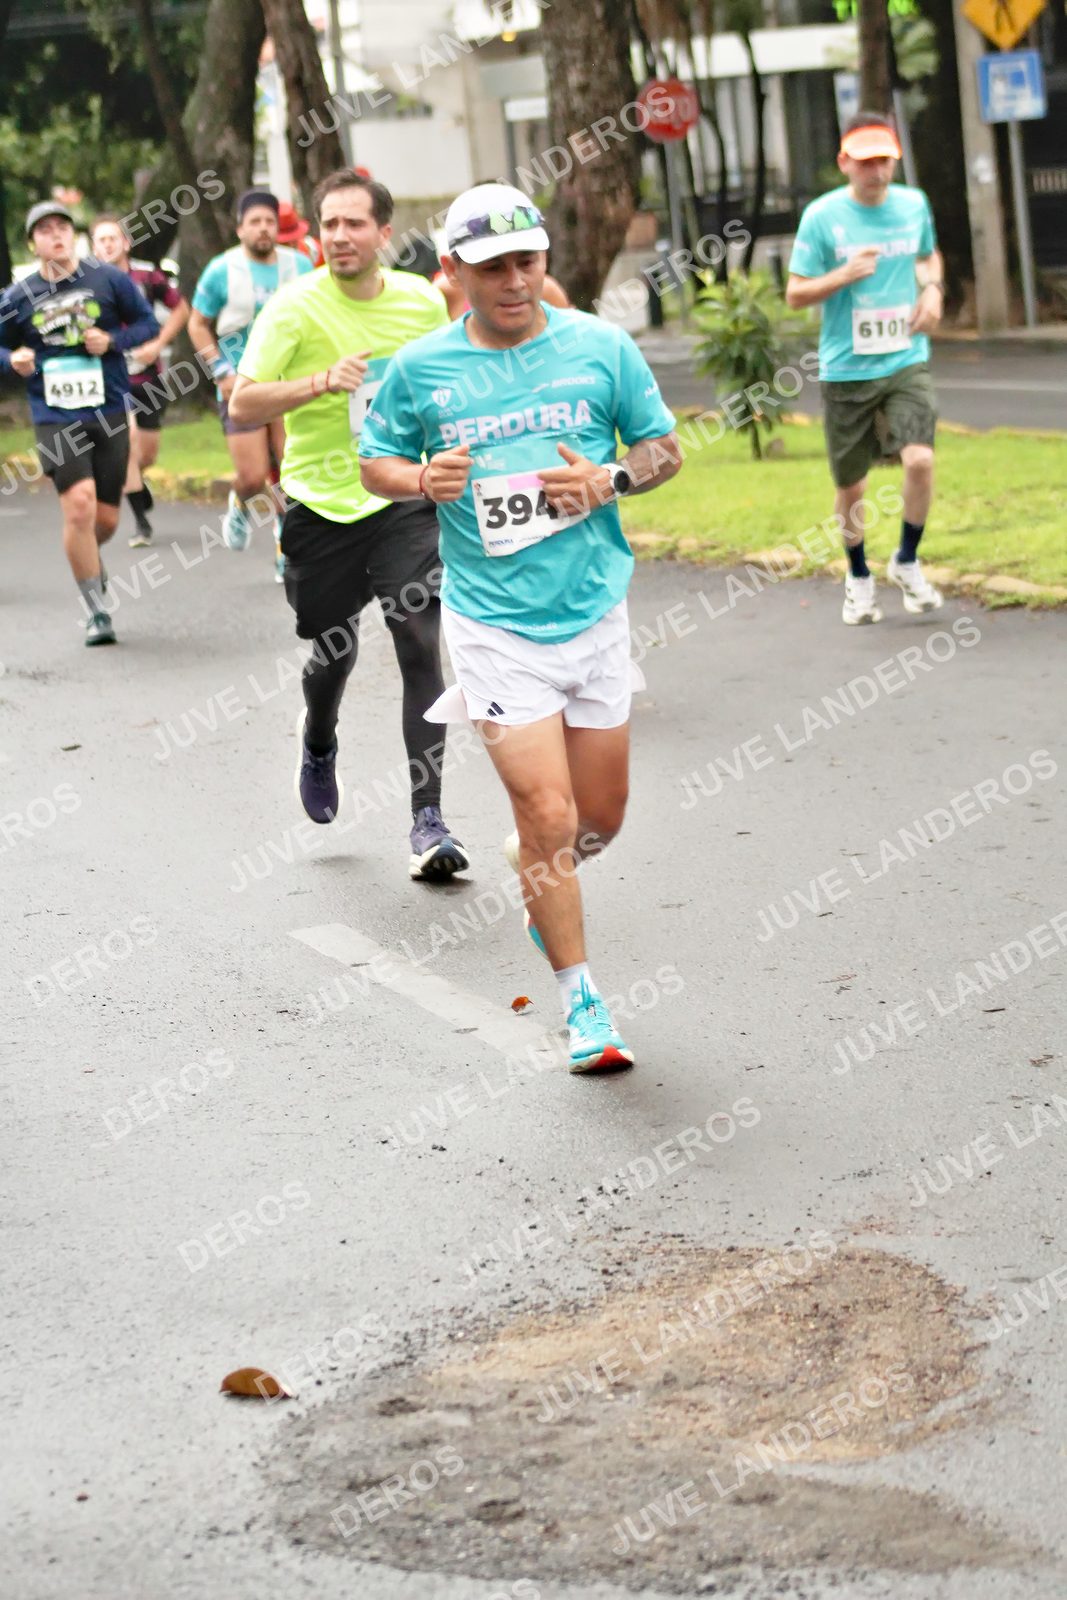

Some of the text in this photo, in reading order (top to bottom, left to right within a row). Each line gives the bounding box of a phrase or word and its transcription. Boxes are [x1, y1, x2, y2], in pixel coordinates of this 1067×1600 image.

[858, 318, 906, 339] 6101
[50, 381, 99, 398] 4912
[552, 376, 596, 388] BROOKS
[439, 400, 593, 449] PERDURA
